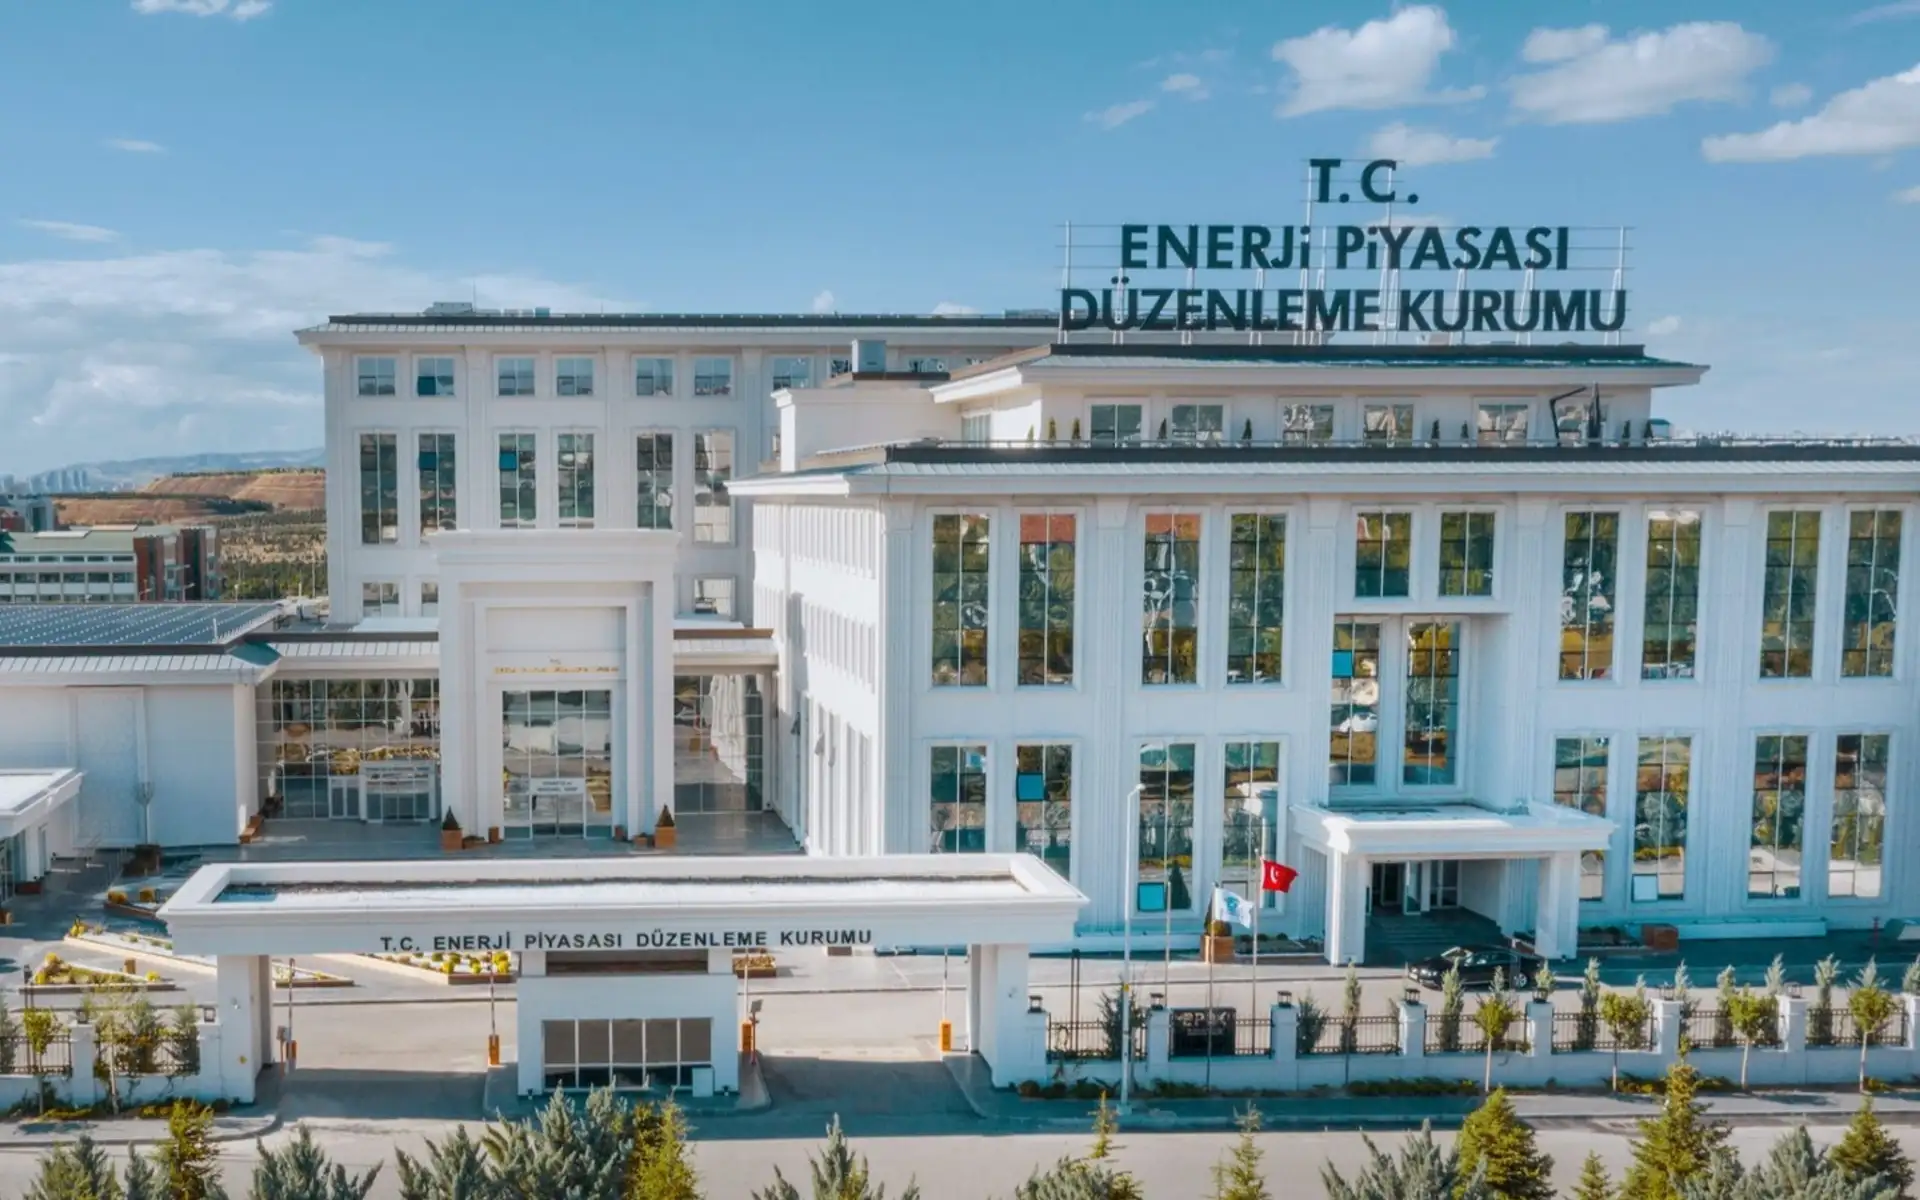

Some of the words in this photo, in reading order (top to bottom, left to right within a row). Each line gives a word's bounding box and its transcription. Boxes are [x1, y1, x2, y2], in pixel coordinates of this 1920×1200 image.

[1062, 277, 1380, 331] DÜZENLEME
[1400, 289, 1627, 331] KURUMU
[380, 936, 420, 952] T.C.
[637, 929, 767, 947] DÜZENLEME
[781, 929, 872, 945] KURUMU
